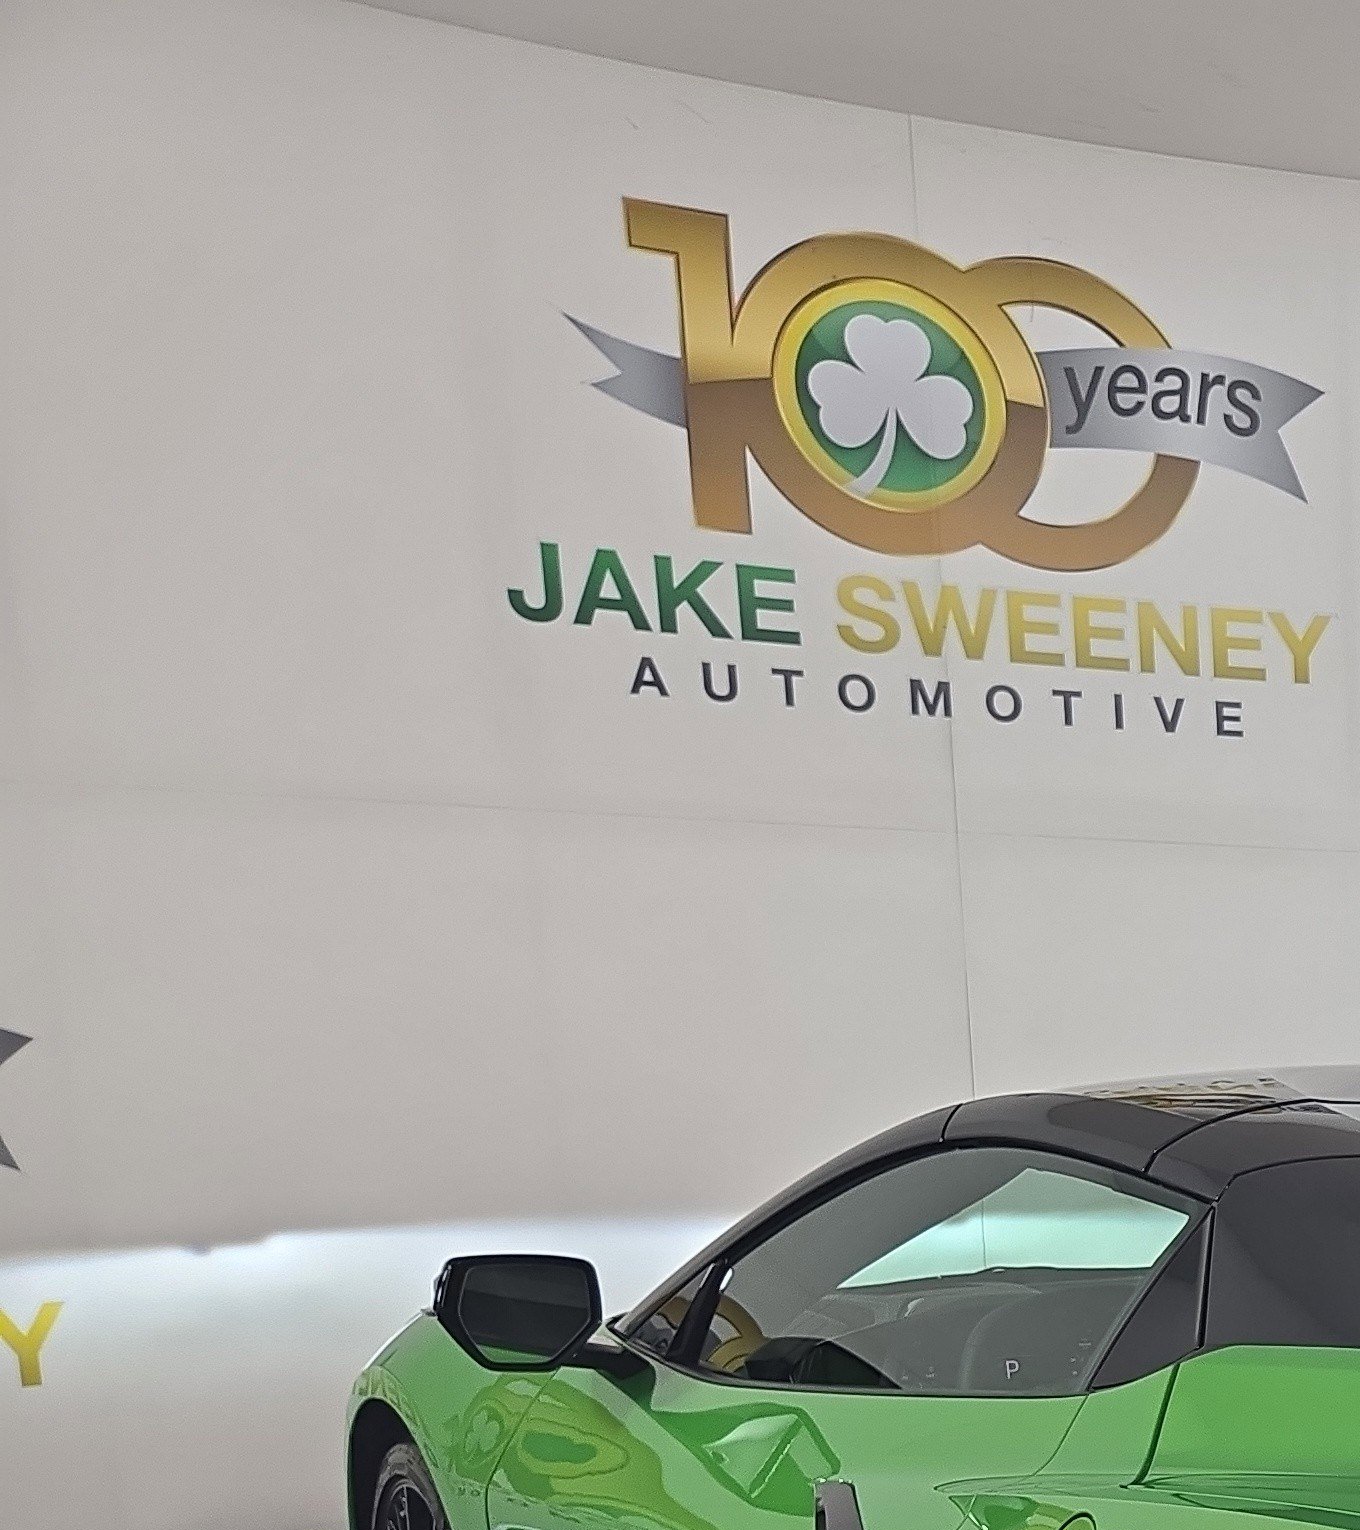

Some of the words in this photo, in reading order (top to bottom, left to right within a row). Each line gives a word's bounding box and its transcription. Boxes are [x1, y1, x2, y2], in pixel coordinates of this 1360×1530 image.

[622, 196, 1202, 573] 100
[1062, 359, 1264, 436] years
[507, 541, 802, 647] JAKE
[836, 574, 1331, 686] SWEENEY
[630, 656, 1245, 738] AUTOMOTIVE
